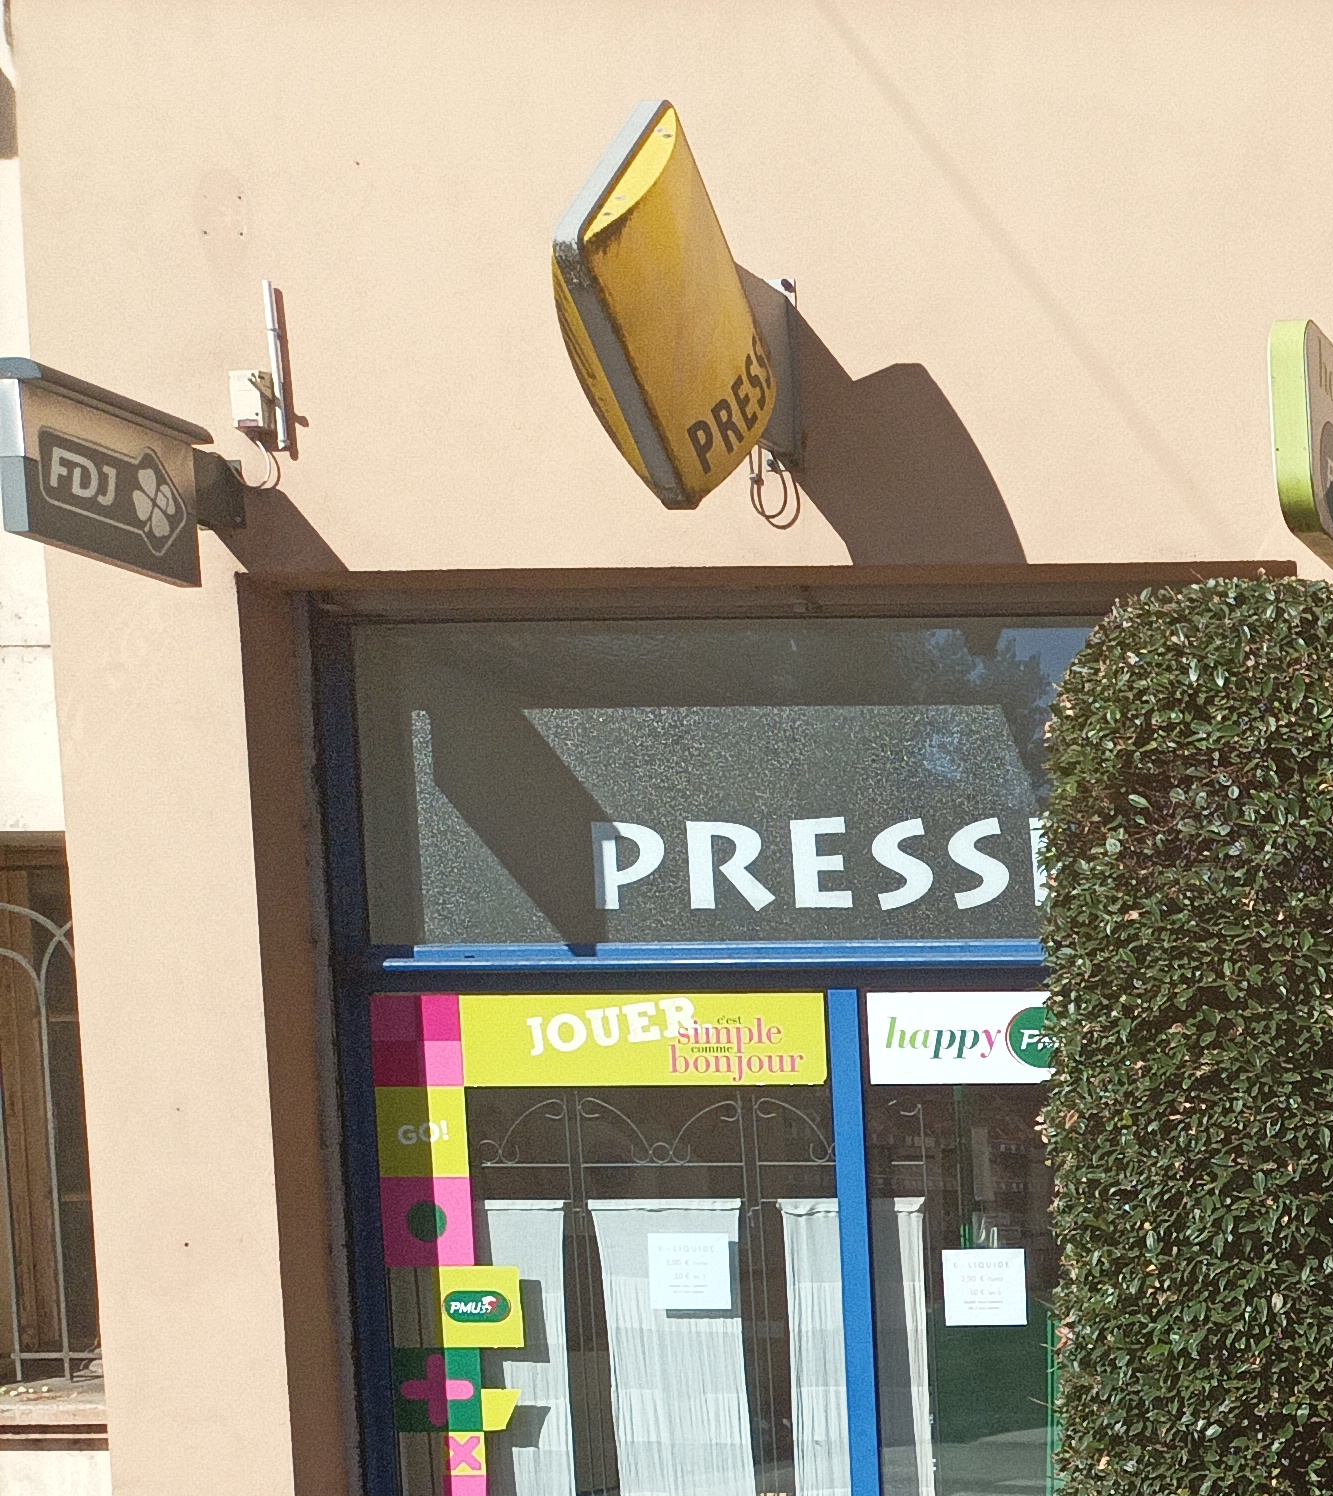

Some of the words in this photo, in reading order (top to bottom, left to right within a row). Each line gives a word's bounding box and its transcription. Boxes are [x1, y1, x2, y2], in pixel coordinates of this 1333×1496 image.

[50, 446, 117, 506] FDJ
[590, 816, 1048, 912] PRESS
[676, 1016, 783, 1054] simple
[716, 1014, 742, 1026] c'est
[885, 1016, 1002, 1060] happy
[668, 1043, 805, 1083] bonjour
[690, 1045, 734, 1054] comme
[397, 1119, 450, 1145] GO!
[449, 1301, 483, 1314] PMU
